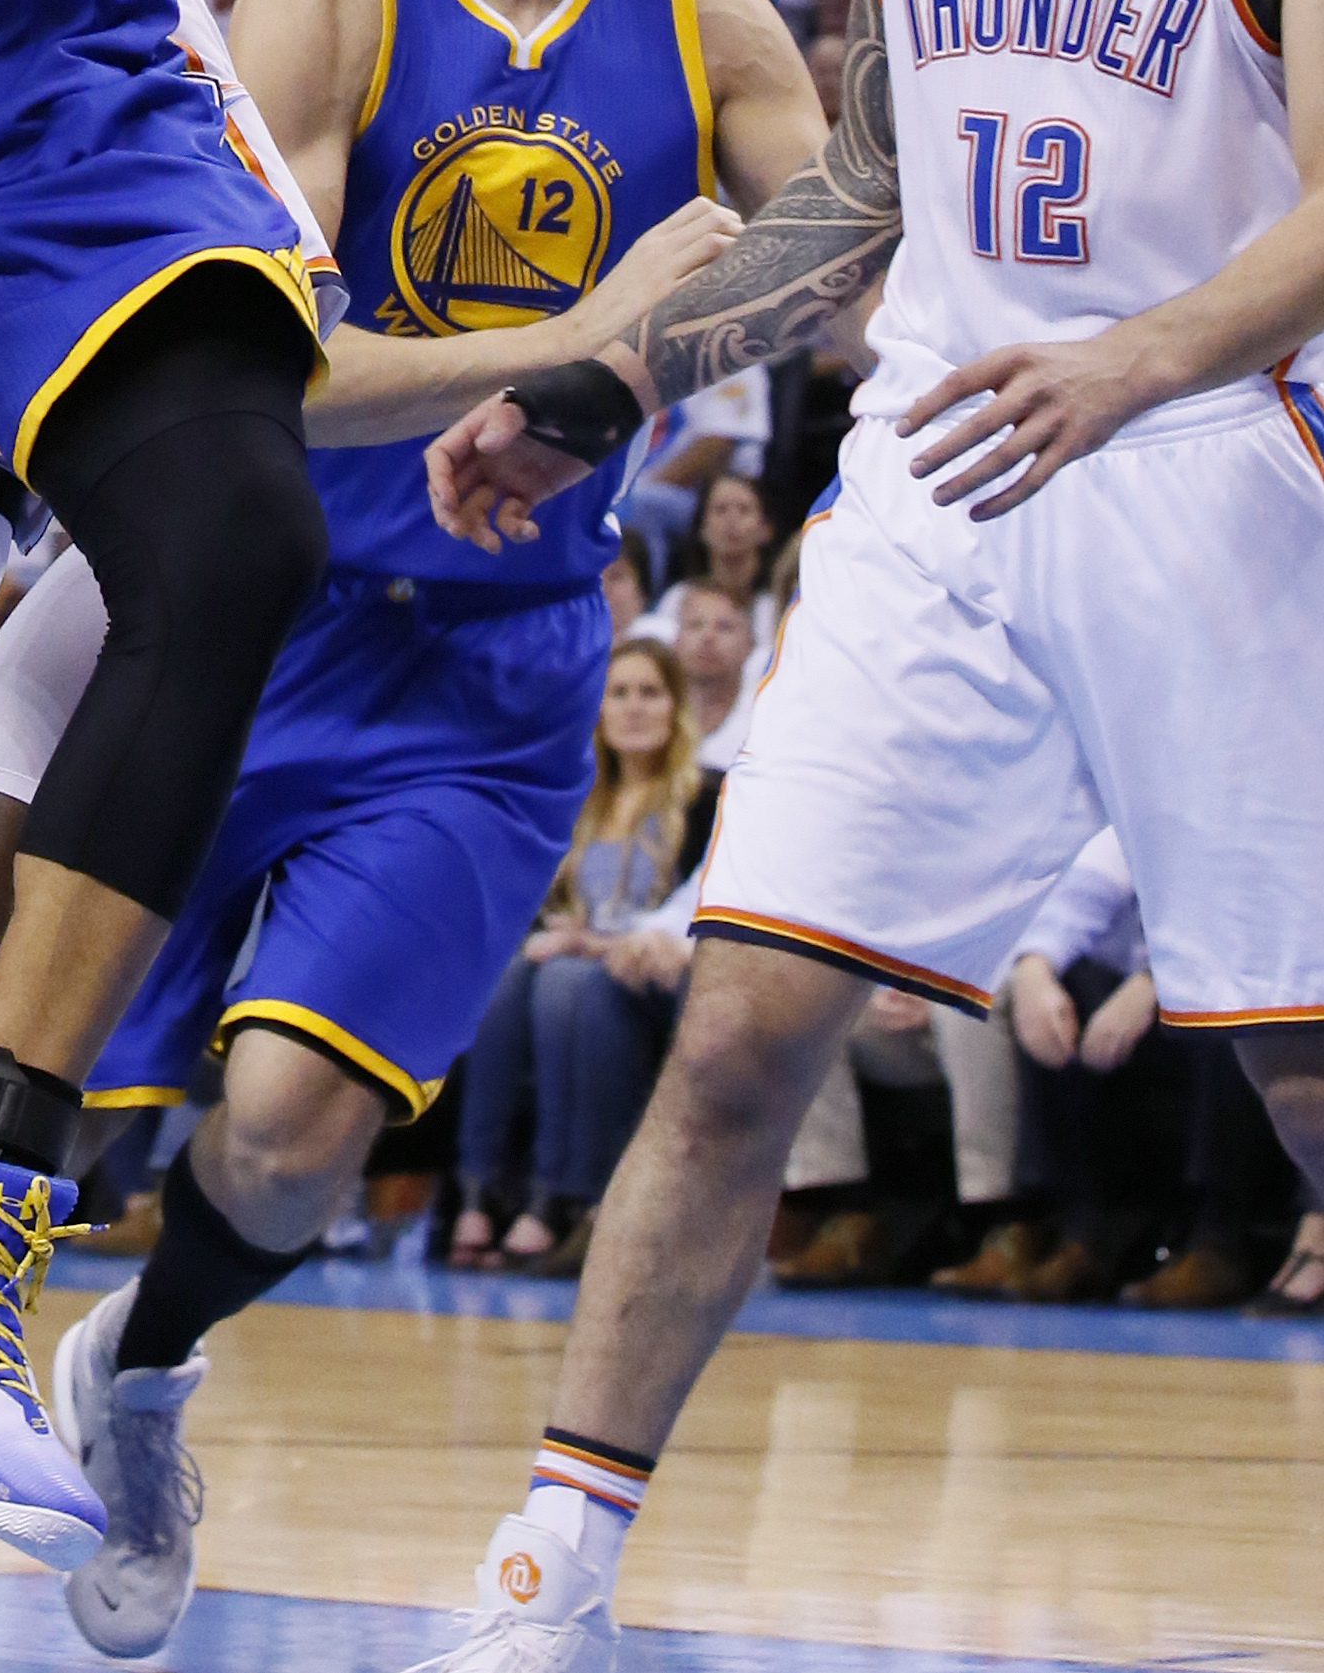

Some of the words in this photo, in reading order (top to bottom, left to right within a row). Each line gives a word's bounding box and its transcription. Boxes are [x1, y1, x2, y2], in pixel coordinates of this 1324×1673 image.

[412, 104, 525, 162] GOLDEN
[535, 112, 623, 185] STATE
[516, 177, 575, 234] 12
[957, 108, 1090, 264] 12
